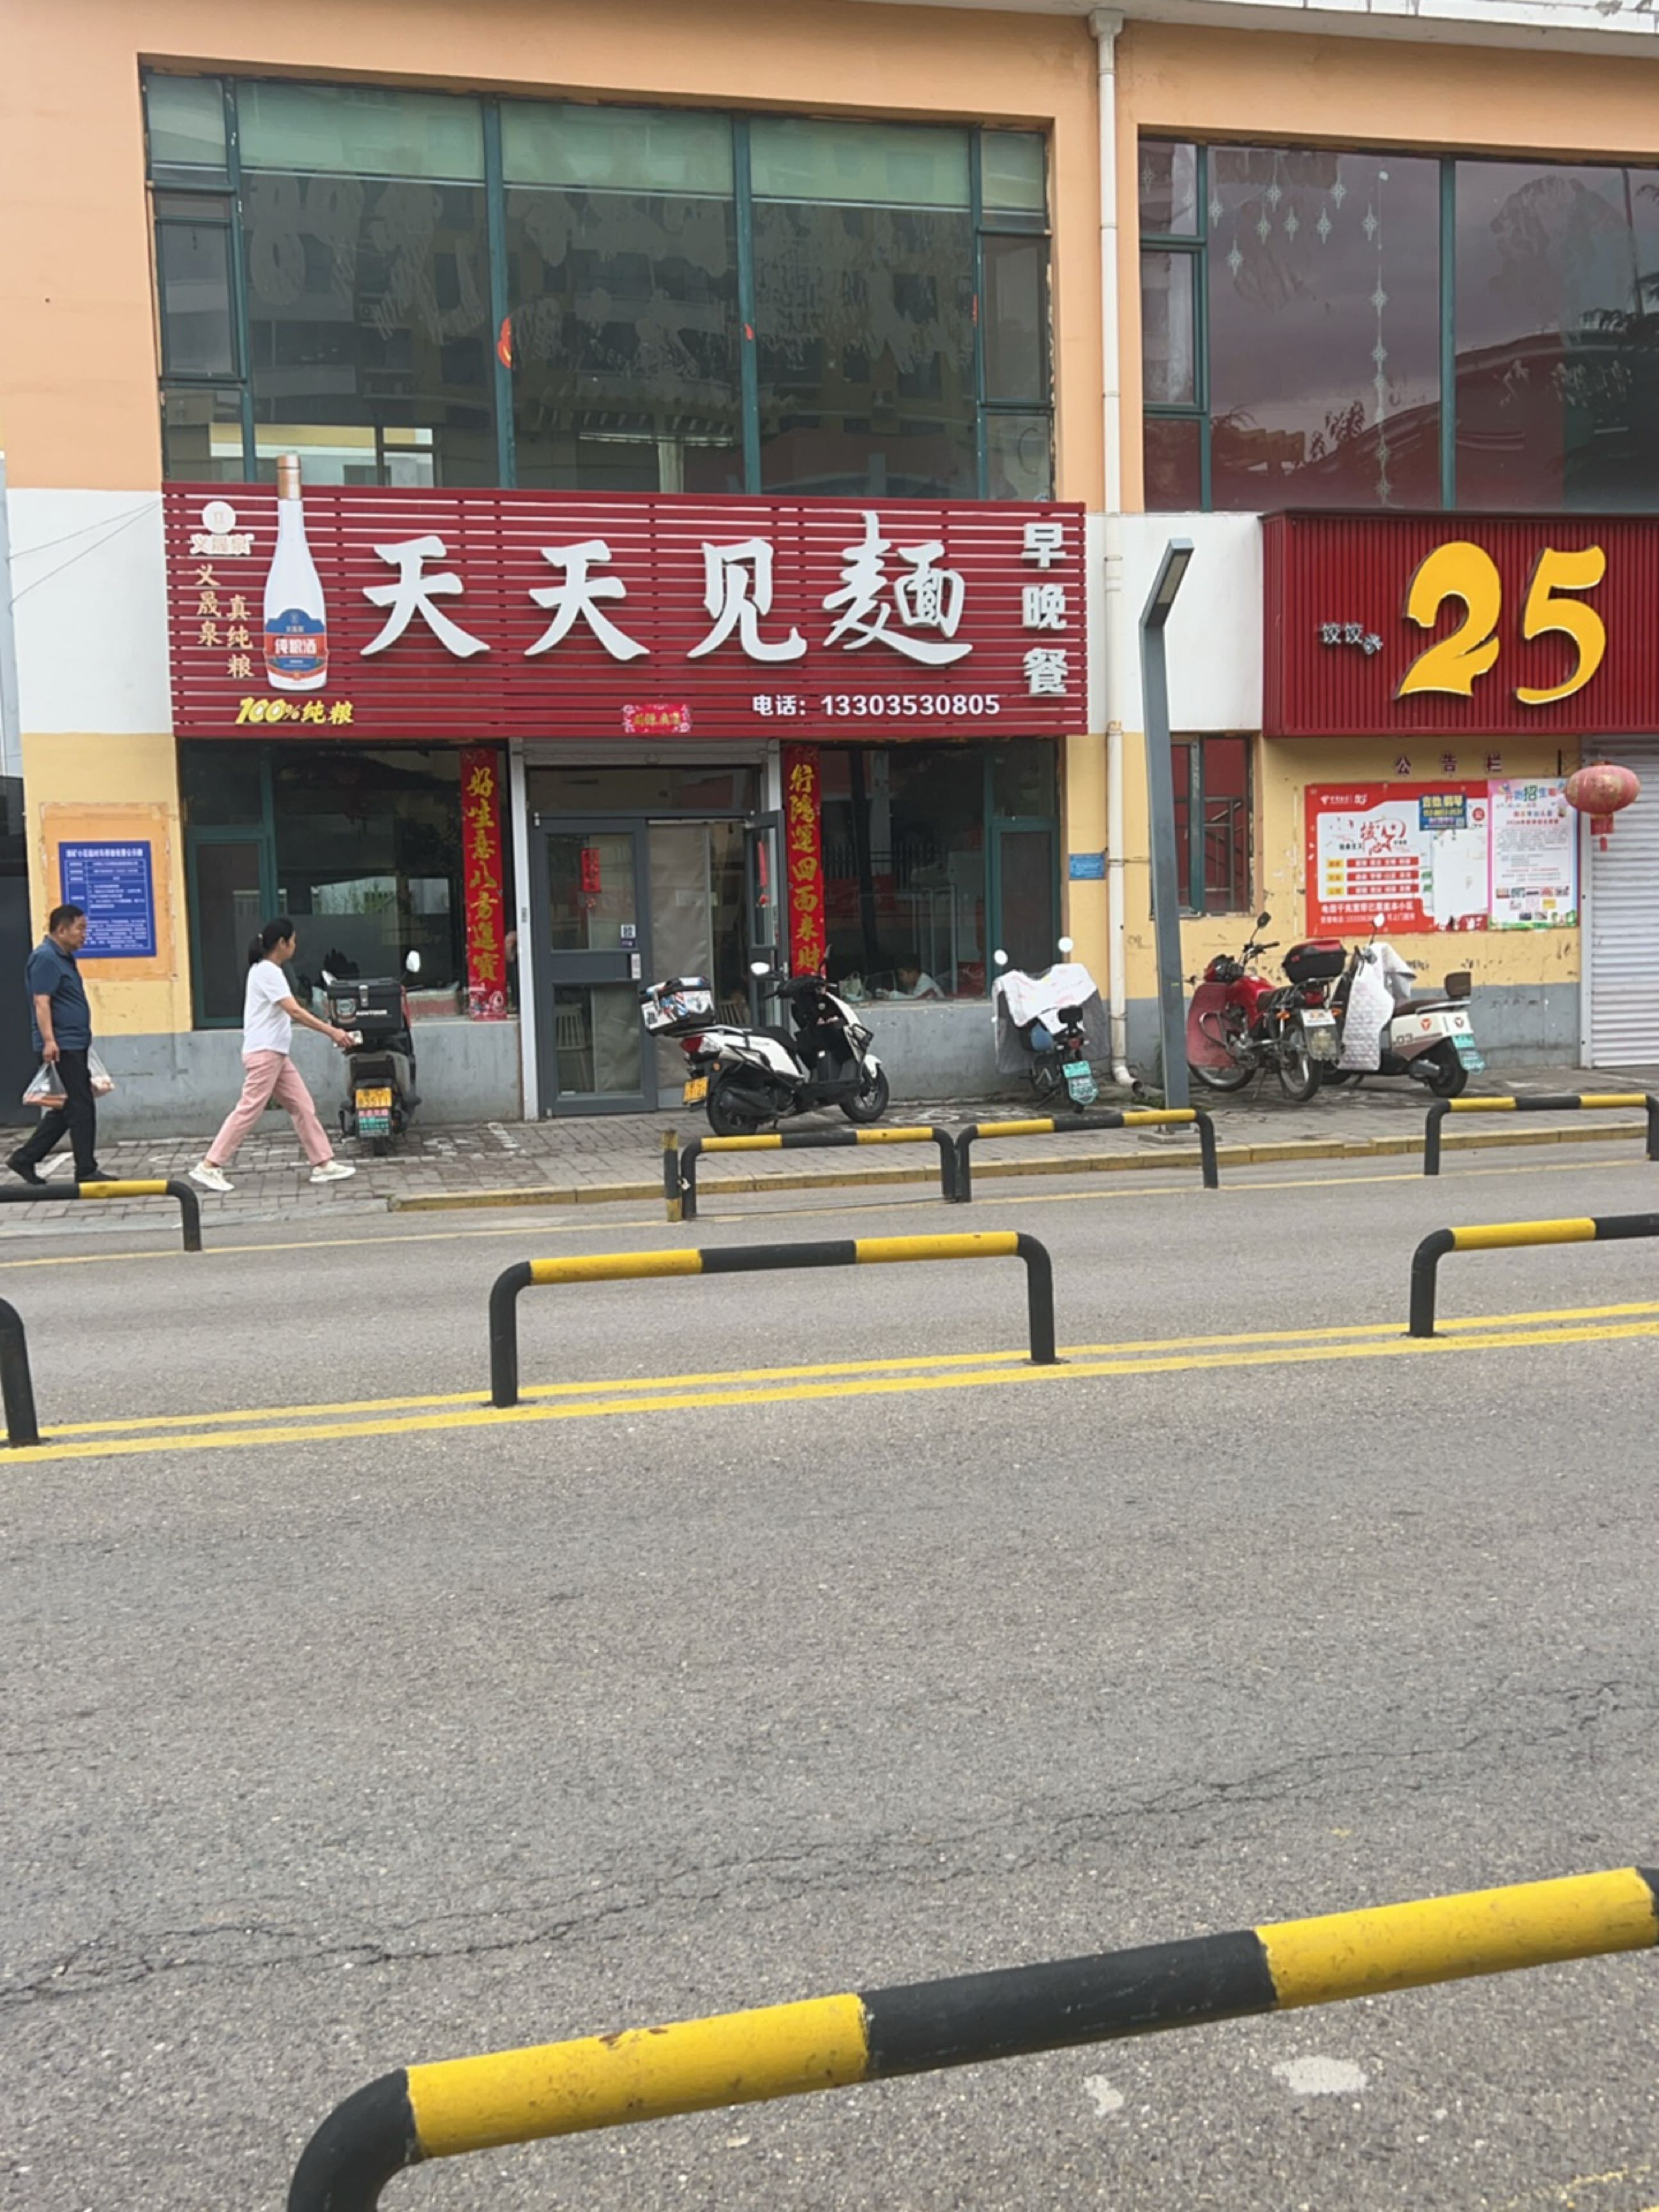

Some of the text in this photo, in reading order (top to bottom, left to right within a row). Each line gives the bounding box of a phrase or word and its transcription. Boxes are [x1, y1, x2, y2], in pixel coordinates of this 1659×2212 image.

[195, 564, 222, 646] 义晟泉
[227, 594, 255, 678] 真纯粮
[1021, 522, 1068, 694] 早晚餐
[1395, 540, 1607, 705] 25
[821, 694, 1001, 716] 13303530805
[1395, 752, 1502, 775] 公告栏
